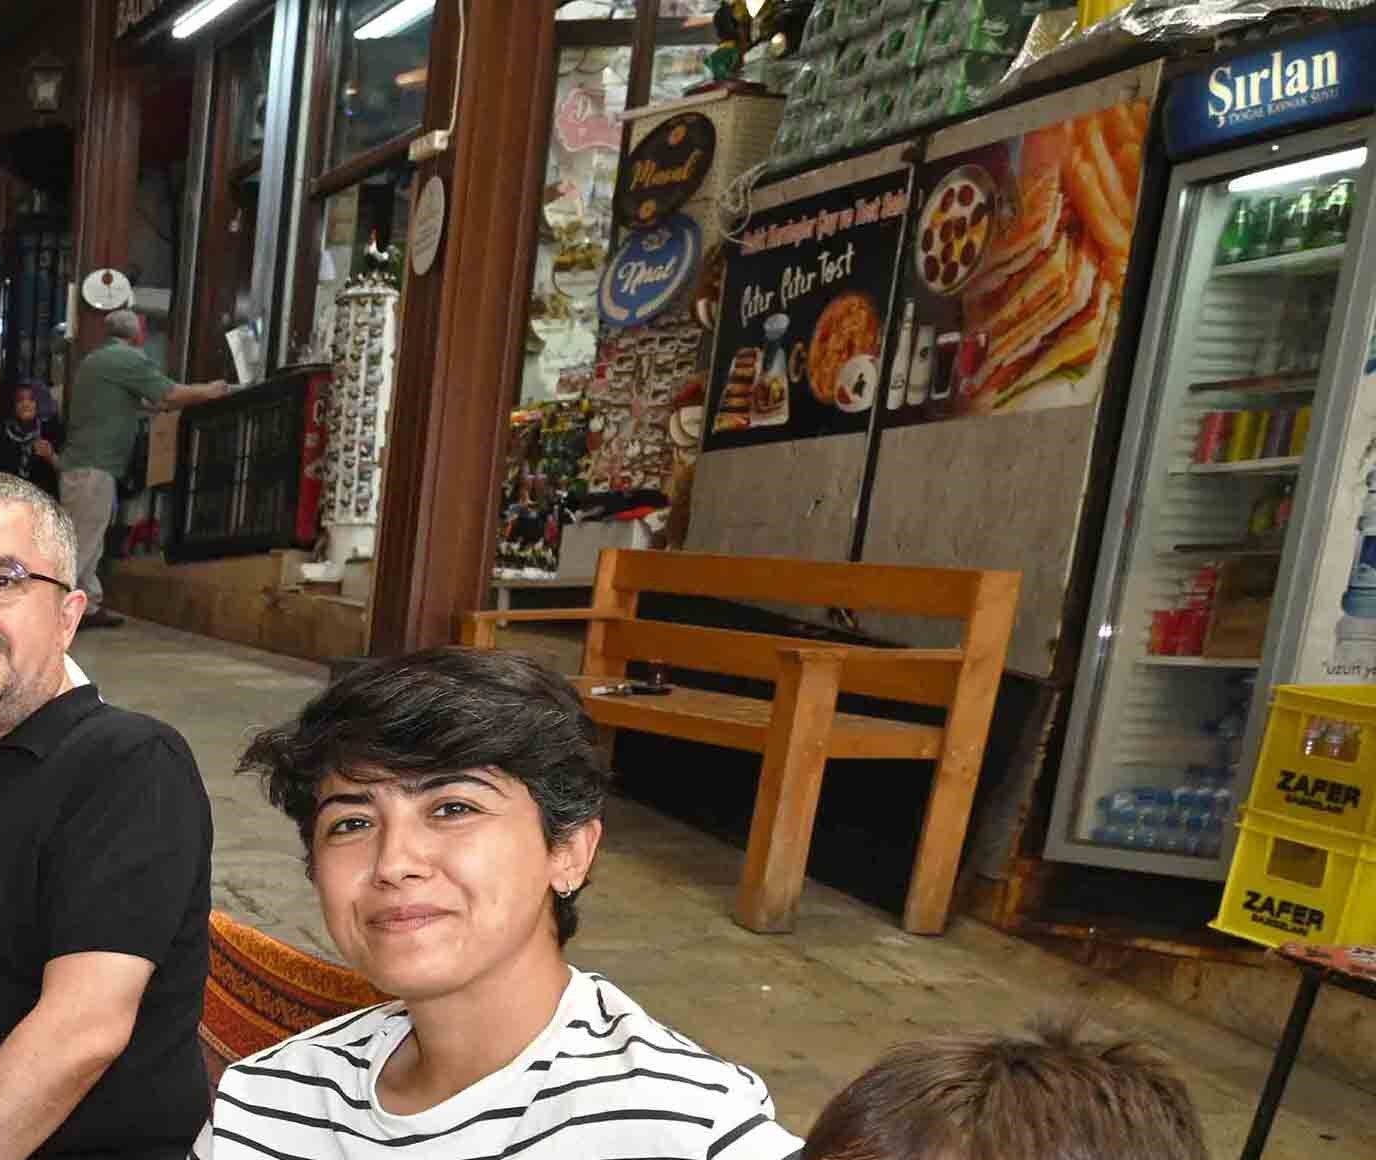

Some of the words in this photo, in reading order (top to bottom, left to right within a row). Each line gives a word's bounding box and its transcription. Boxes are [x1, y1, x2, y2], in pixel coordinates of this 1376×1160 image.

[1208, 50, 1340, 128] Şırlan
[1276, 769, 1361, 808] ZAFER
[1242, 889, 1326, 931] ZAFER
